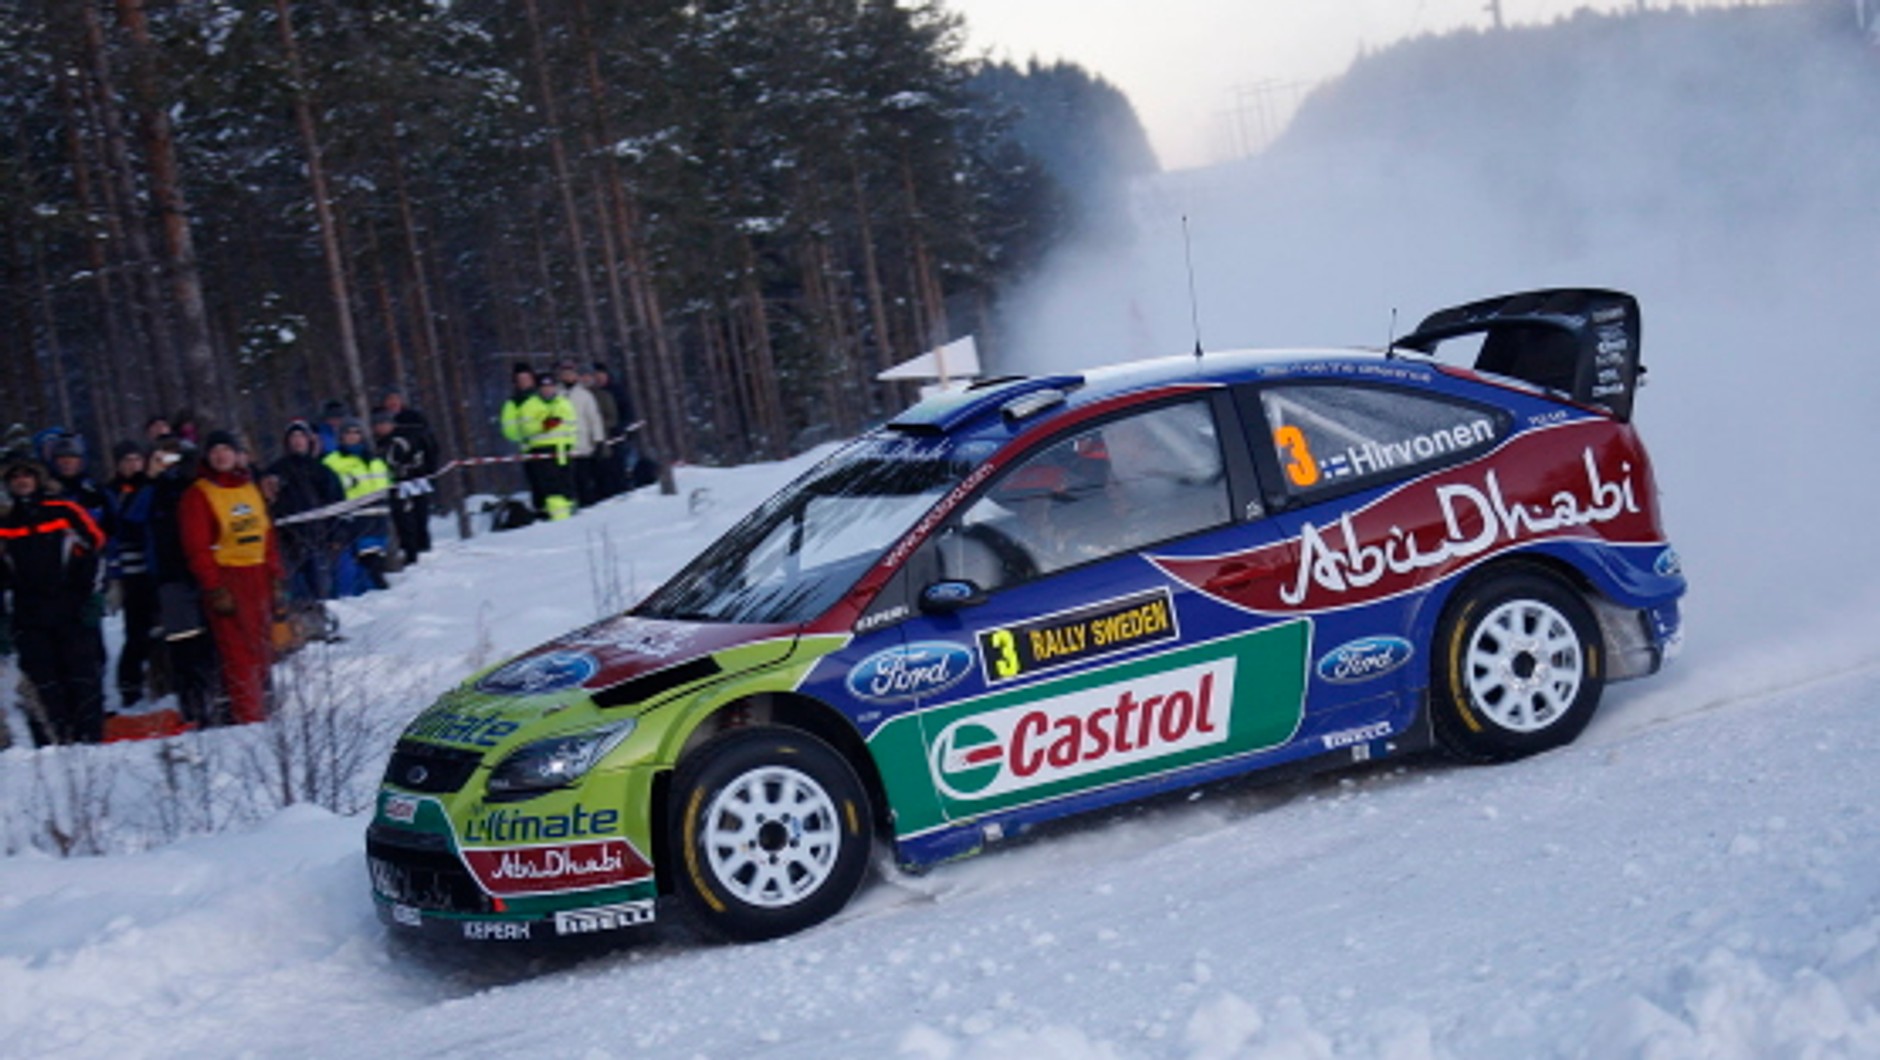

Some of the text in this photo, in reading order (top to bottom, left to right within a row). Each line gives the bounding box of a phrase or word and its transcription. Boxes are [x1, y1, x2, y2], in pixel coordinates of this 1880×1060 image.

[1274, 425, 1320, 486] 3
[1350, 417, 1495, 477] Hirvonen
[1280, 446, 1640, 606] Abu Dhabi
[991, 599, 1170, 678] 3 RALLY SWEDEN
[1333, 642, 1396, 680] Ford
[870, 652, 950, 695] Ford
[1008, 673, 1215, 778] Castrol
[543, 843, 623, 878] Dhabi
